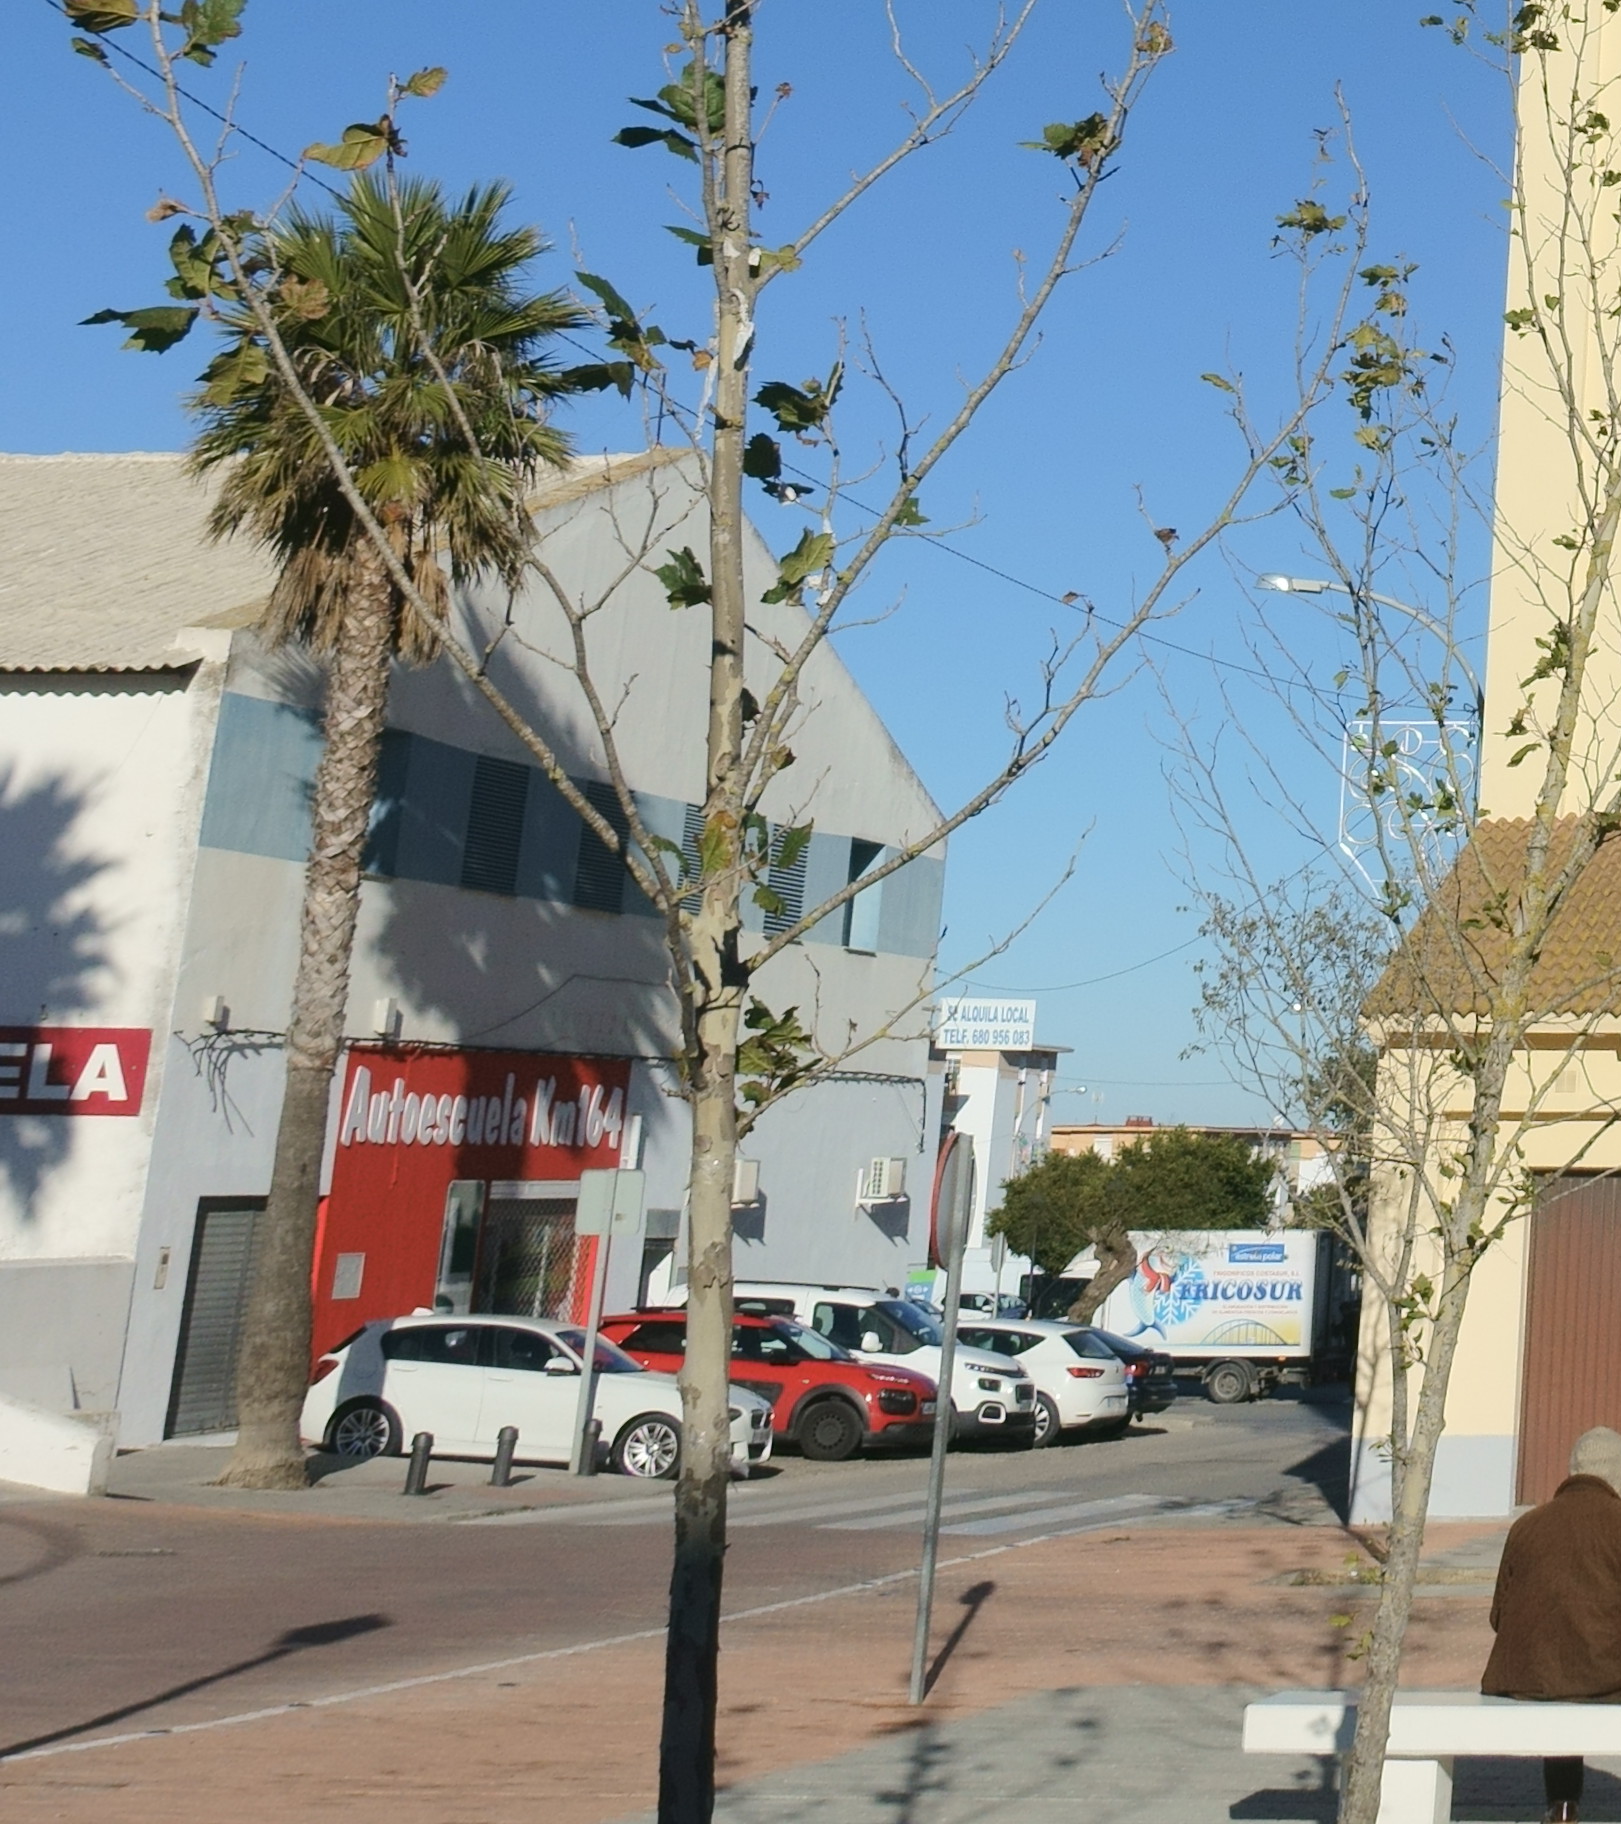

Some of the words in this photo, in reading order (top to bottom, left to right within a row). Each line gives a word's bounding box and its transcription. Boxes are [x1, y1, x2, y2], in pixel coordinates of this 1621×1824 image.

[961, 1005, 999, 1023] ALQUILA
[1001, 1006, 1030, 1023] LOCAL
[944, 1028, 970, 1045] TELF.
[972, 1029, 990, 1045] 680
[992, 1029, 1010, 1045] 956
[1012, 1029, 1030, 1045] 083
[339, 1065, 528, 1146] Autoescuela
[1179, 1278, 1303, 1301] FRICOSUR
